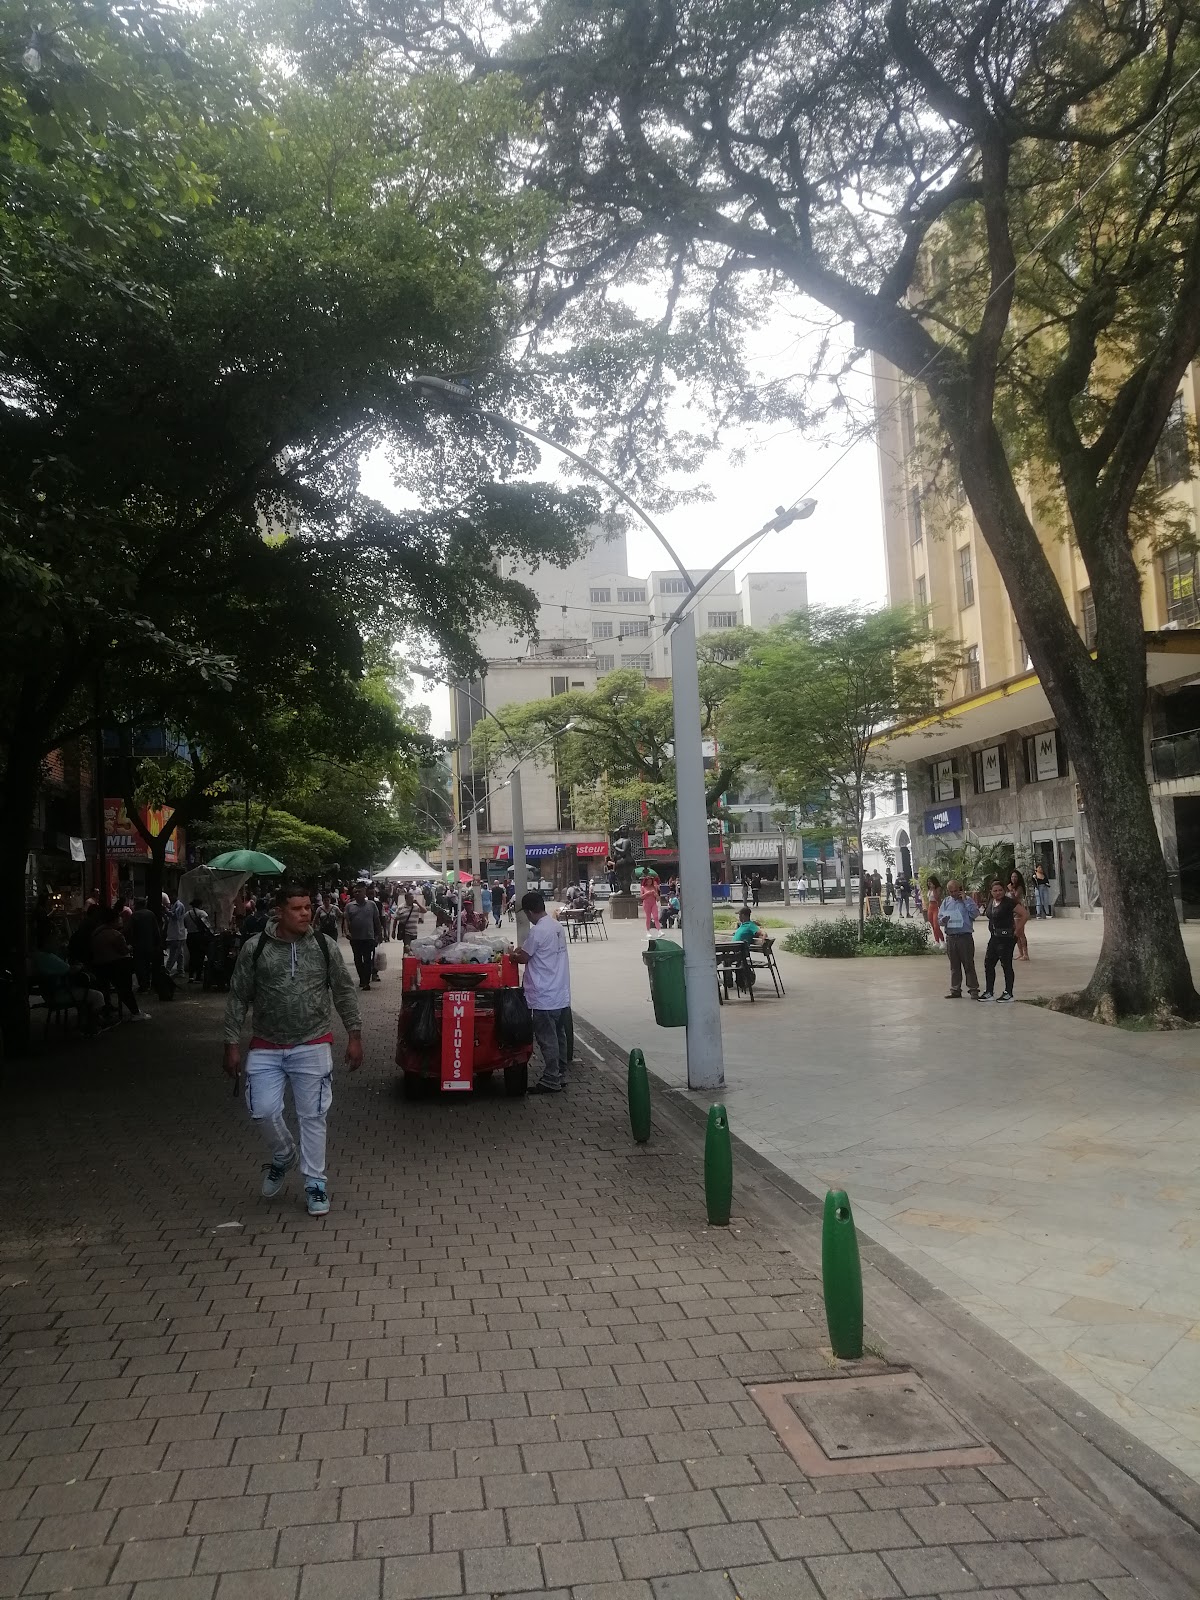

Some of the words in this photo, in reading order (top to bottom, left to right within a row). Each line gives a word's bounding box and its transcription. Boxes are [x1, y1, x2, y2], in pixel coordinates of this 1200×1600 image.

[106, 835, 136, 846] MIL
[576, 845, 605, 854] steur
[758, 841, 793, 853] PRECS
[449, 991, 470, 1003] aquí
[453, 1006, 464, 1078] Minutos
